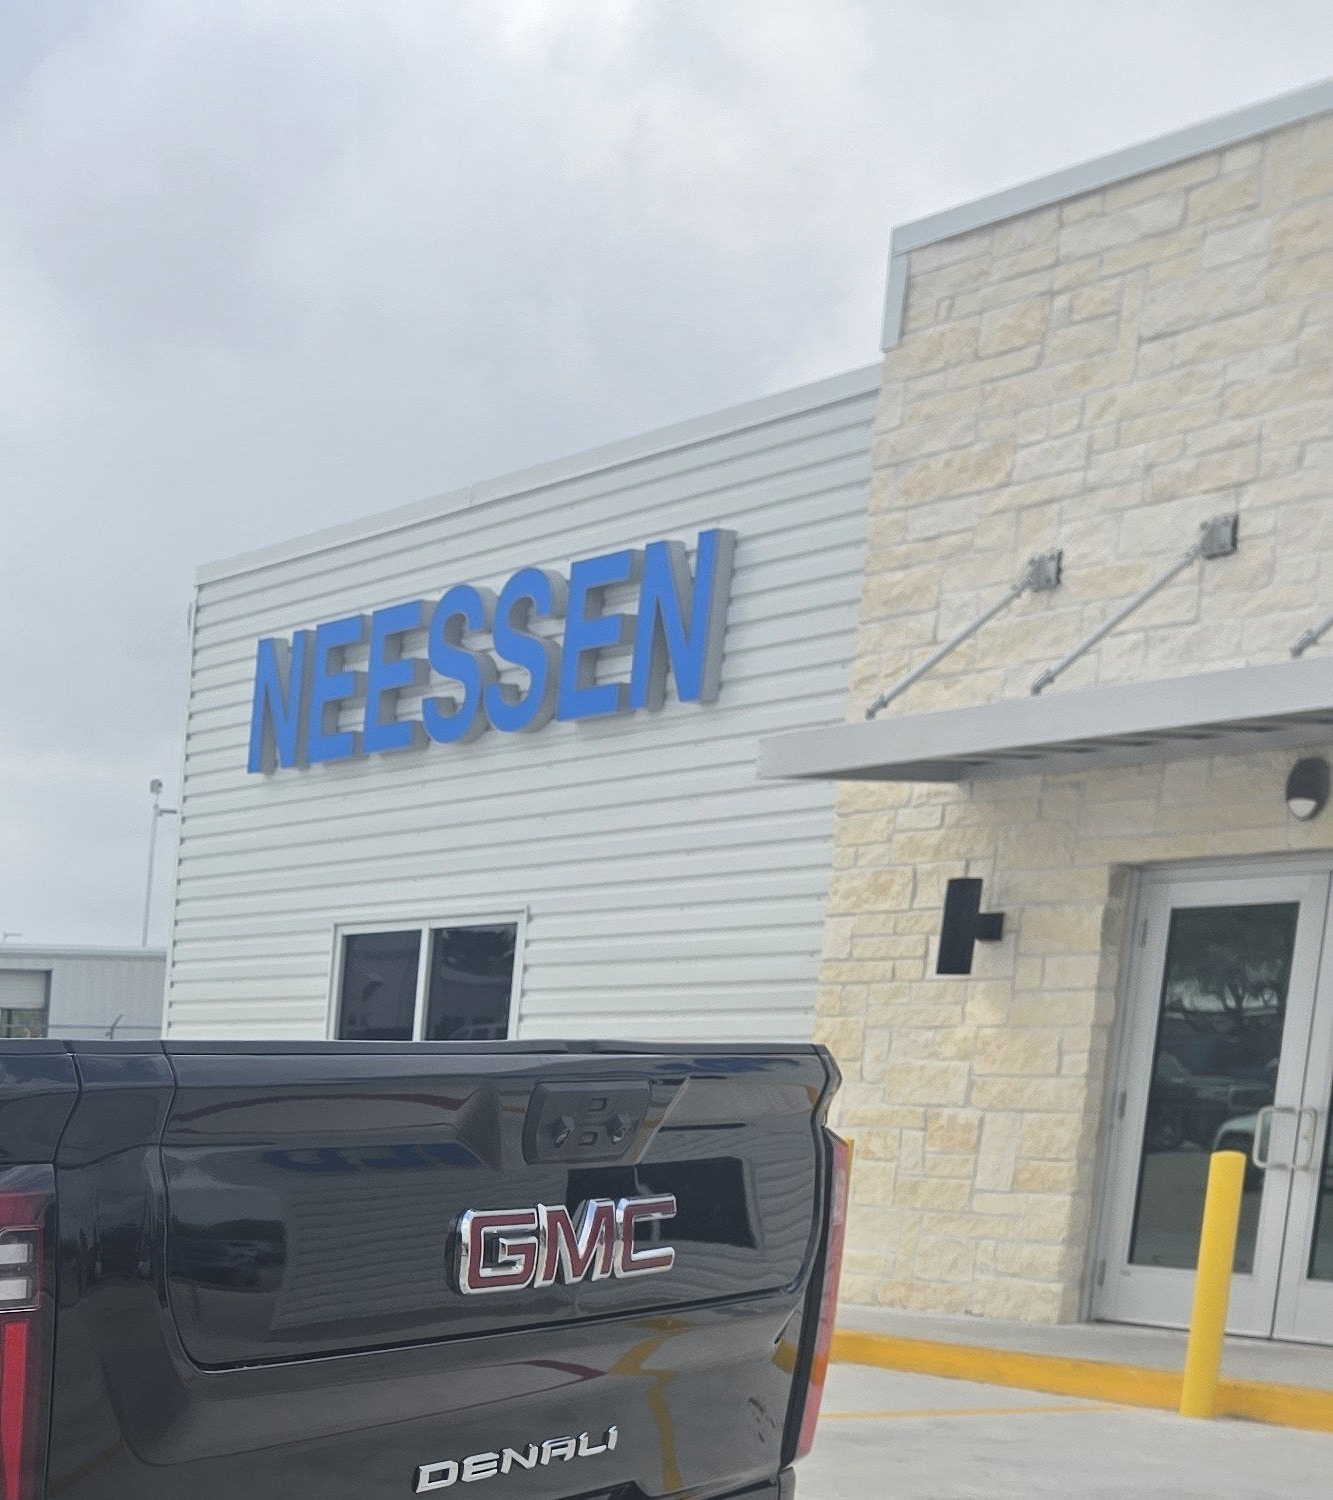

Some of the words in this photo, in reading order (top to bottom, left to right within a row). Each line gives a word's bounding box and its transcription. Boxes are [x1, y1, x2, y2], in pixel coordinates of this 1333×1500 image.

[247, 528, 735, 774] NEESSEN
[458, 1193, 677, 1295] GMC
[414, 1425, 619, 1494] DENALI
